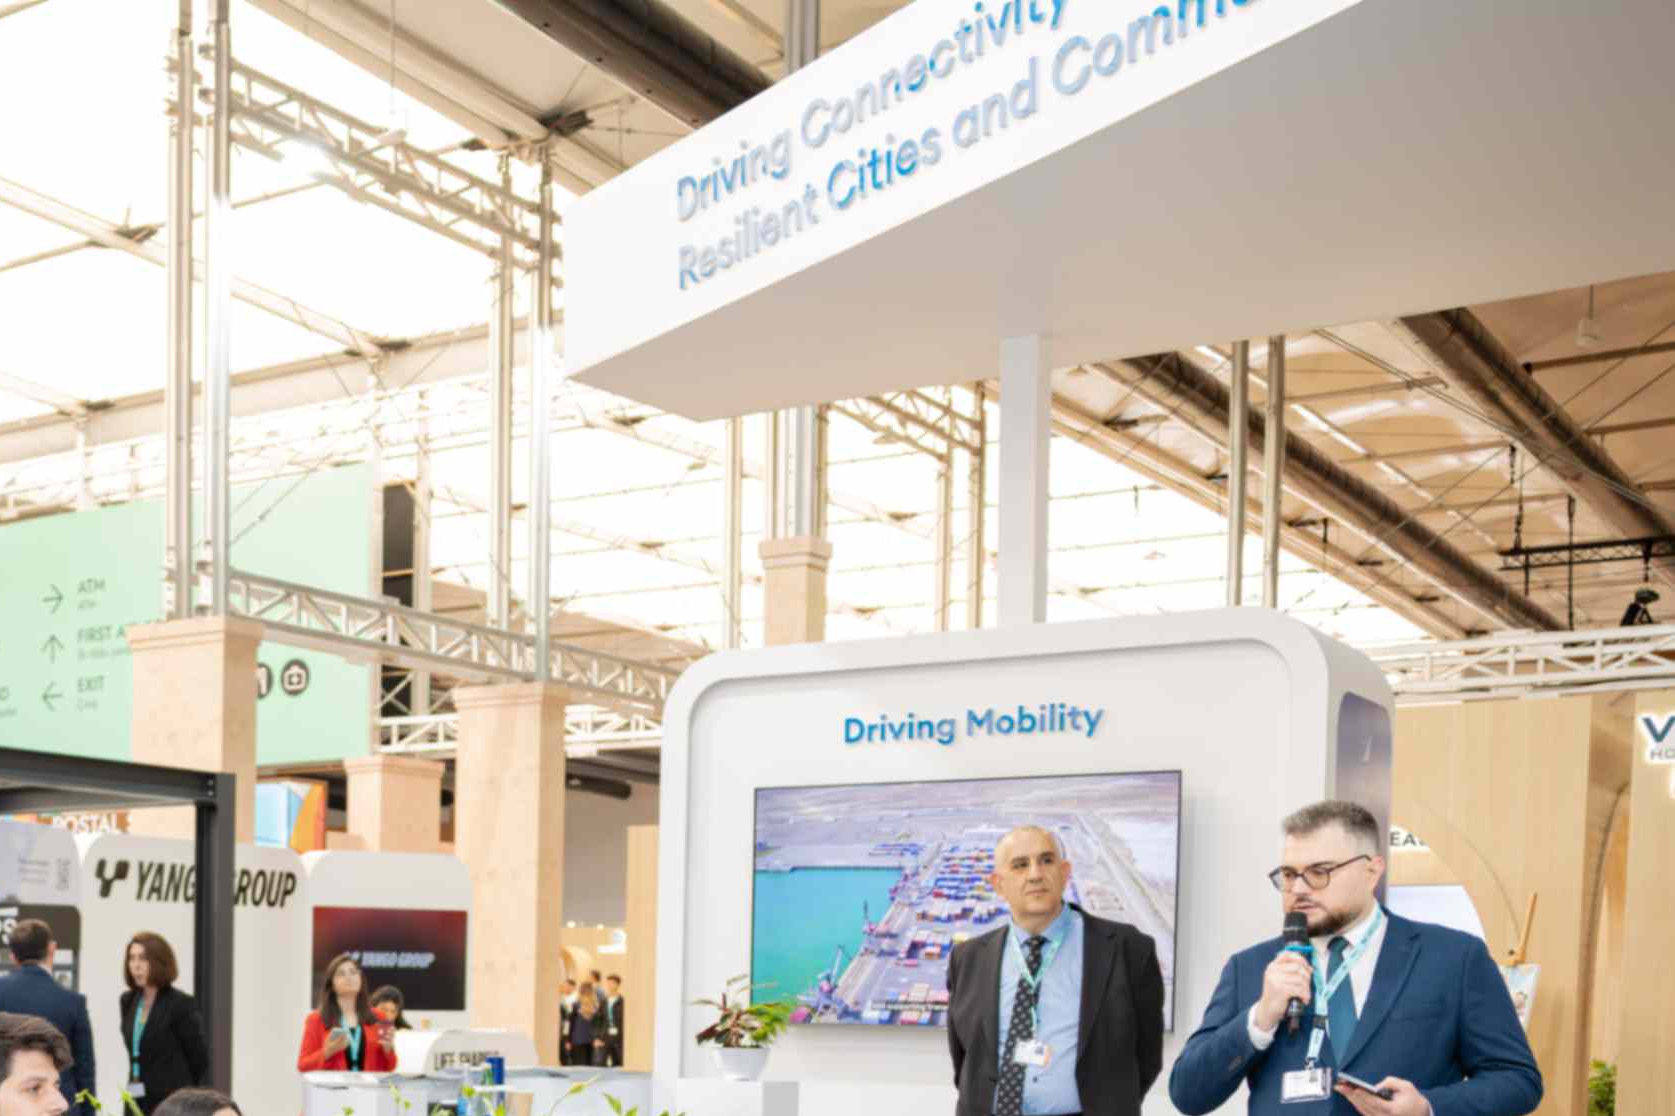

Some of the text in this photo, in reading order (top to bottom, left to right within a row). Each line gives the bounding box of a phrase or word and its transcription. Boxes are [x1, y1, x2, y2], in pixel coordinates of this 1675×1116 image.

[676, 130, 792, 222] Driving
[678, 183, 821, 290] Resilient
[827, 126, 942, 211] Cities
[952, 56, 1038, 148] and
[77, 578, 106, 594] ATM
[77, 675, 104, 693] EXIT
[843, 702, 1105, 746] Driving Mobility
